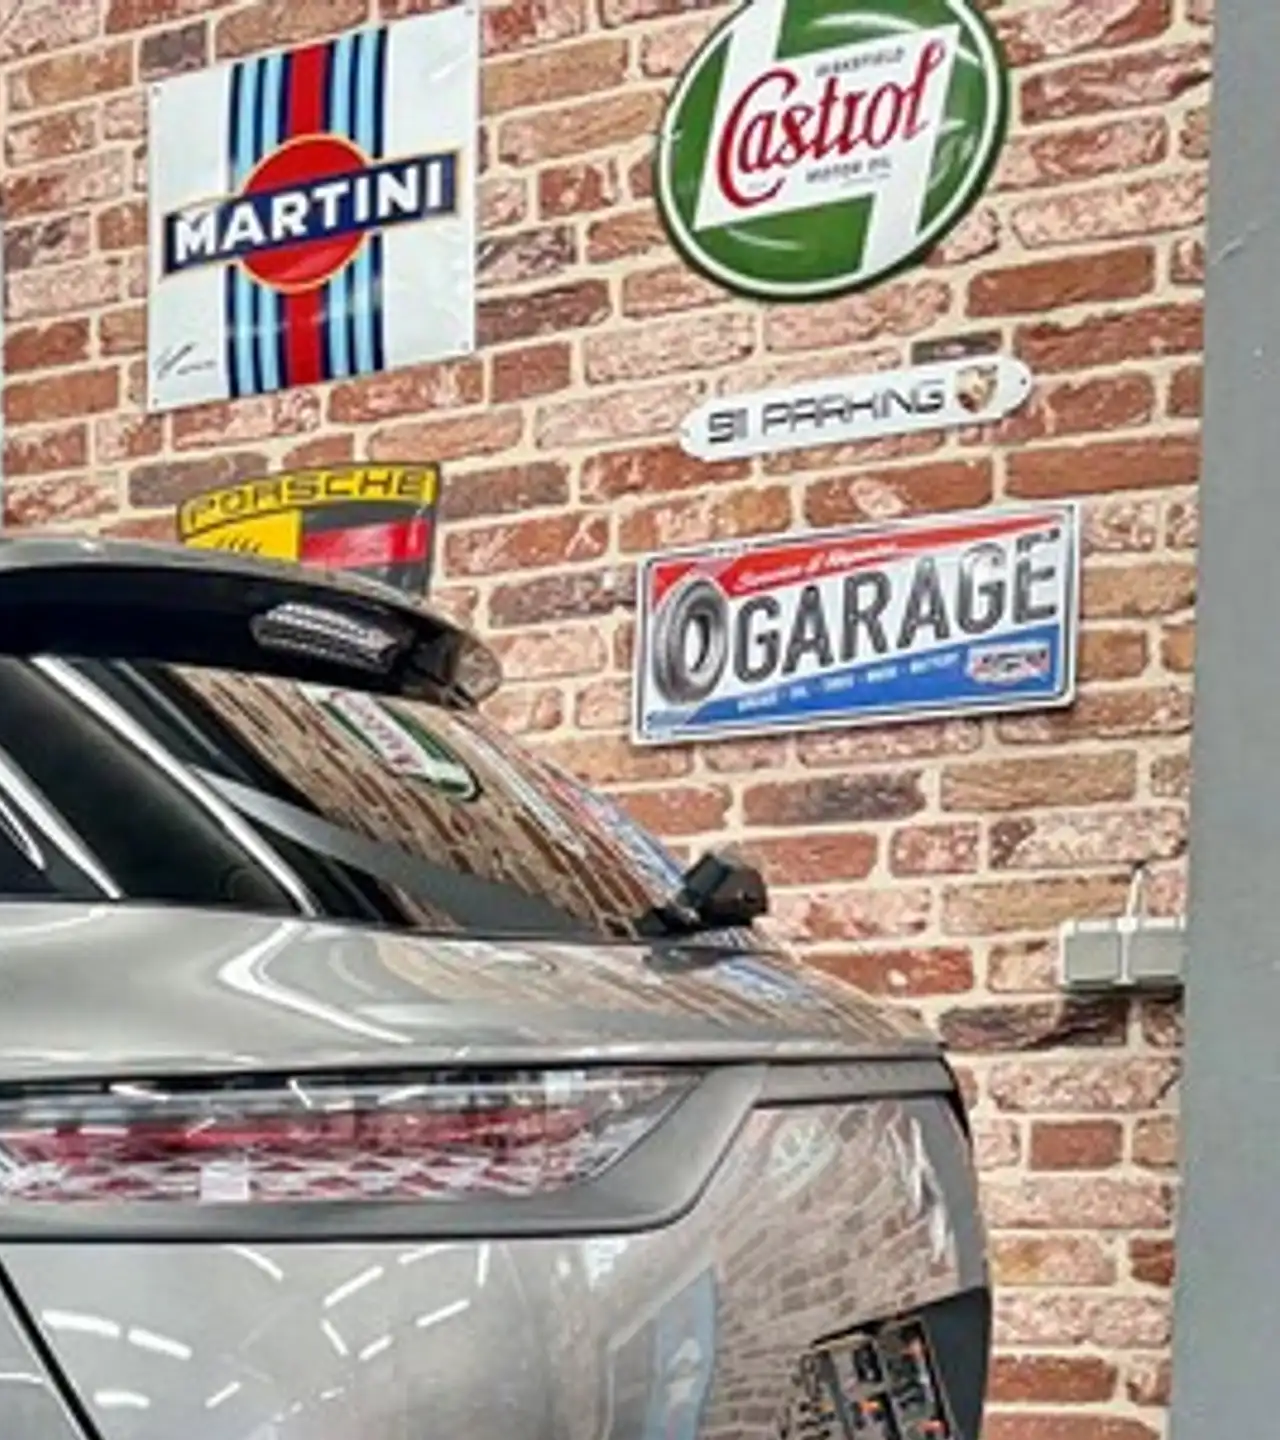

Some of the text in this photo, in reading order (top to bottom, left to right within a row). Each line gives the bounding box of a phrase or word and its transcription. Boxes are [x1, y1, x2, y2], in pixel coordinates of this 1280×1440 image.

[717, 37, 947, 208] Castrol
[174, 161, 443, 263] MARTINI
[761, 378, 946, 437] PARKING
[189, 469, 425, 526] PORSCHE
[733, 528, 1061, 685] GARAGE
